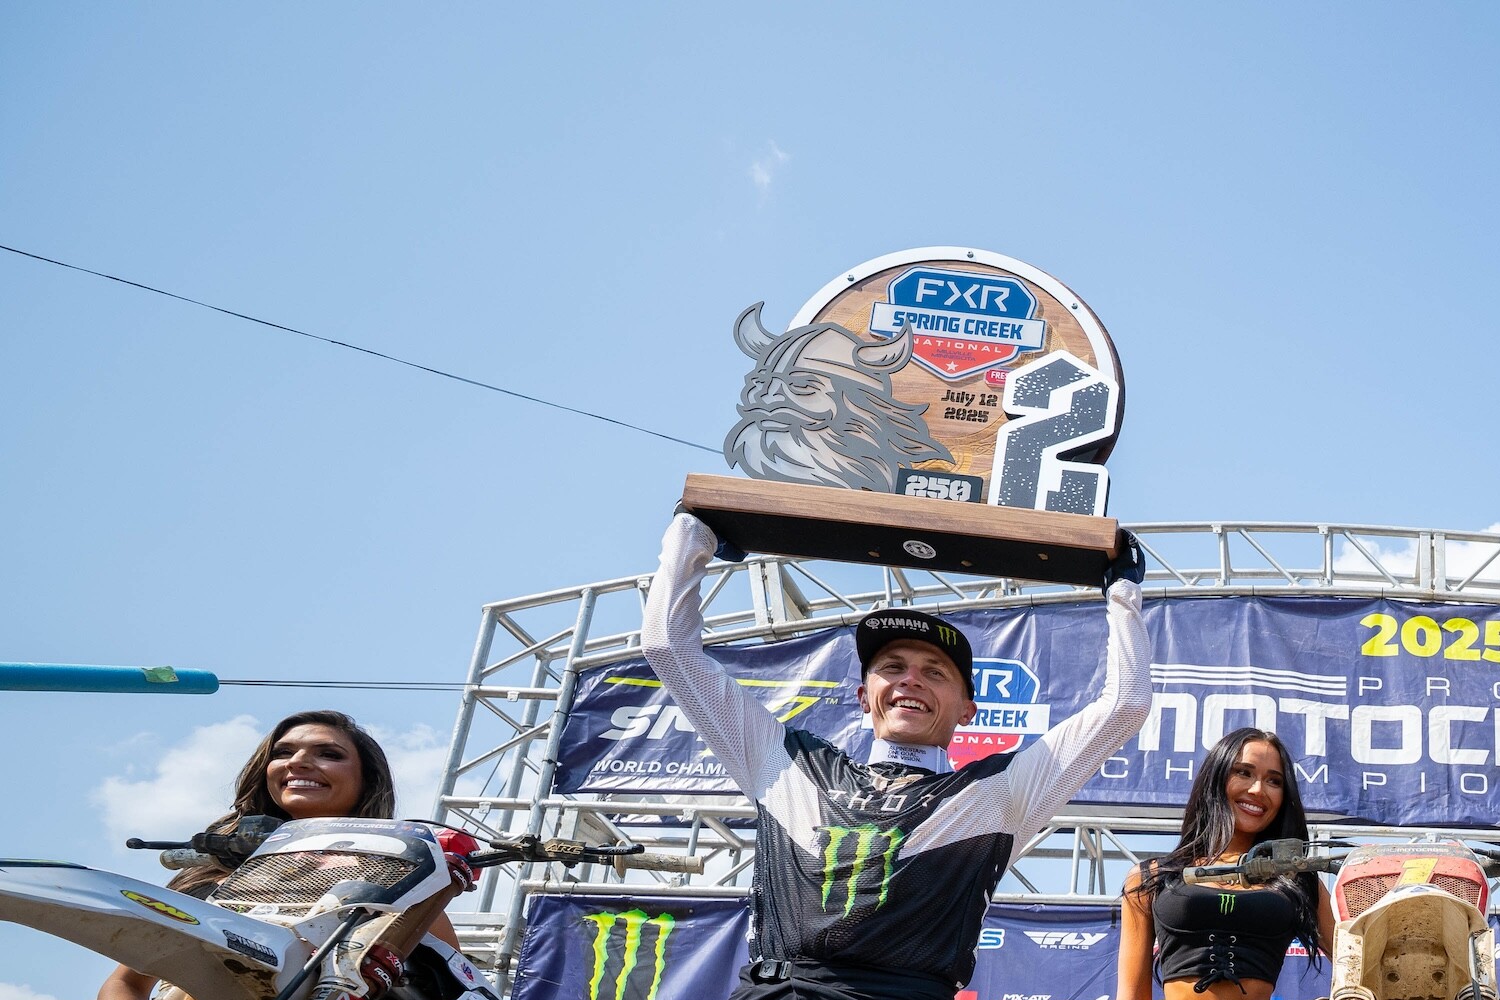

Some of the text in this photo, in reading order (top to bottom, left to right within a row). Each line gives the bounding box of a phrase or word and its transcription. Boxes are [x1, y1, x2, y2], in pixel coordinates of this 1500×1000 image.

[916, 278, 1010, 312] FXR
[892, 311, 1024, 340] SPRING CREEK
[914, 339, 1002, 353] NATIONAL
[941, 389, 999, 408] July 12
[944, 407, 990, 424] 2025
[987, 349, 1119, 519] 2
[905, 474, 973, 502] 250
[879, 616, 930, 631] YAMAHA
[593, 760, 662, 774] WORLD
[1023, 930, 1108, 947] FLY
